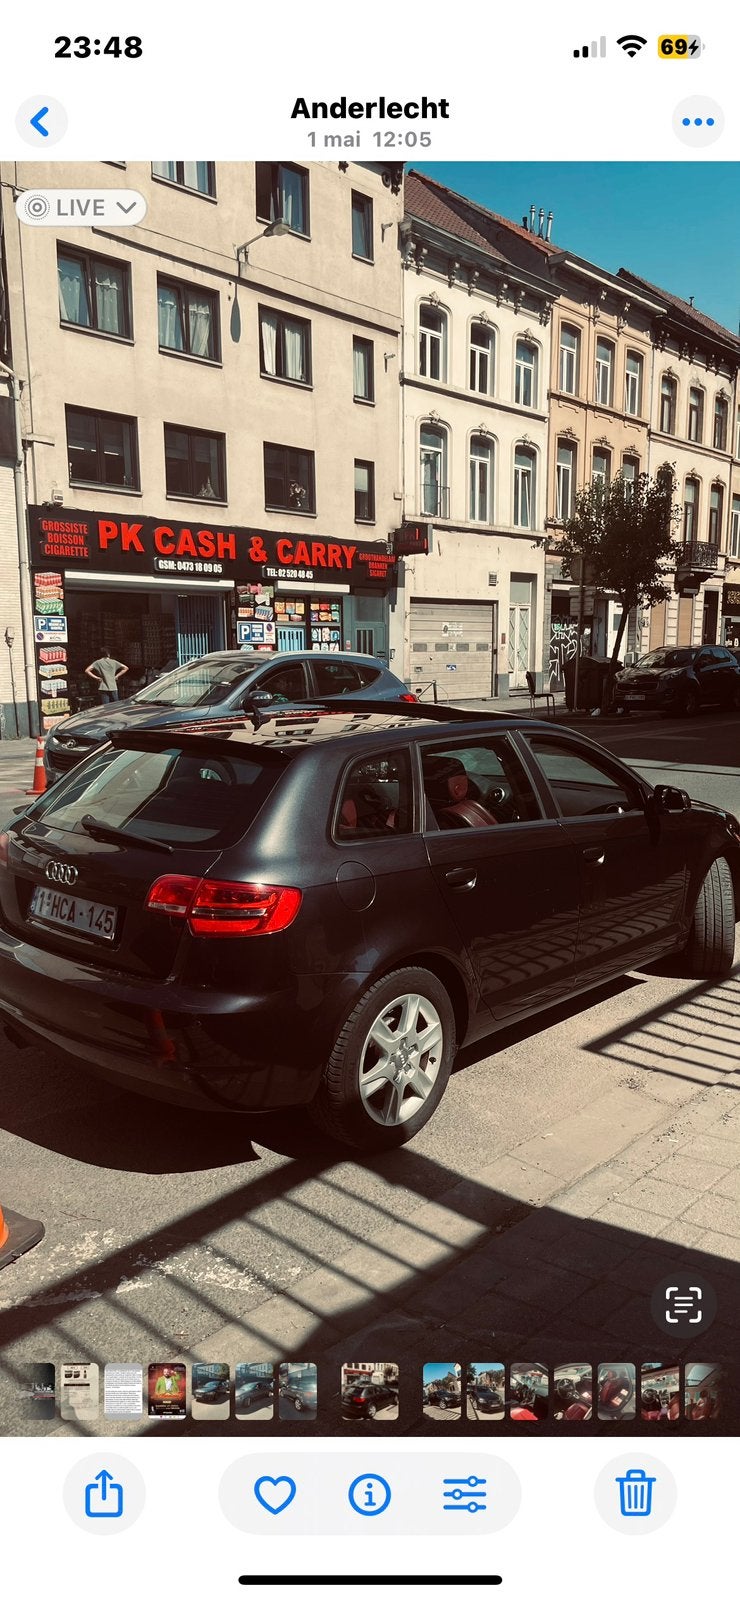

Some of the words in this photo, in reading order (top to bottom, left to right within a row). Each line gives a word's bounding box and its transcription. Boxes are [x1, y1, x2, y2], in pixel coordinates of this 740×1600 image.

[41, 519, 88, 535] GROSSISTE
[47, 532, 85, 546] BOISSON
[97, 519, 146, 553] PK
[154, 526, 237, 561] CASH
[248, 536, 269, 564] &
[276, 538, 357, 569] CARRY
[44, 544, 89, 557] CIGARETTE
[158, 559, 177, 570] GSM:
[177, 561, 194, 572] 0473
[195, 562, 203, 572] 18
[204, 563, 213, 573] 09
[213, 563, 223, 573] 05
[305, 570, 314, 579] 45
[38, 618, 46, 630] P
[241, 625, 250, 640] P
